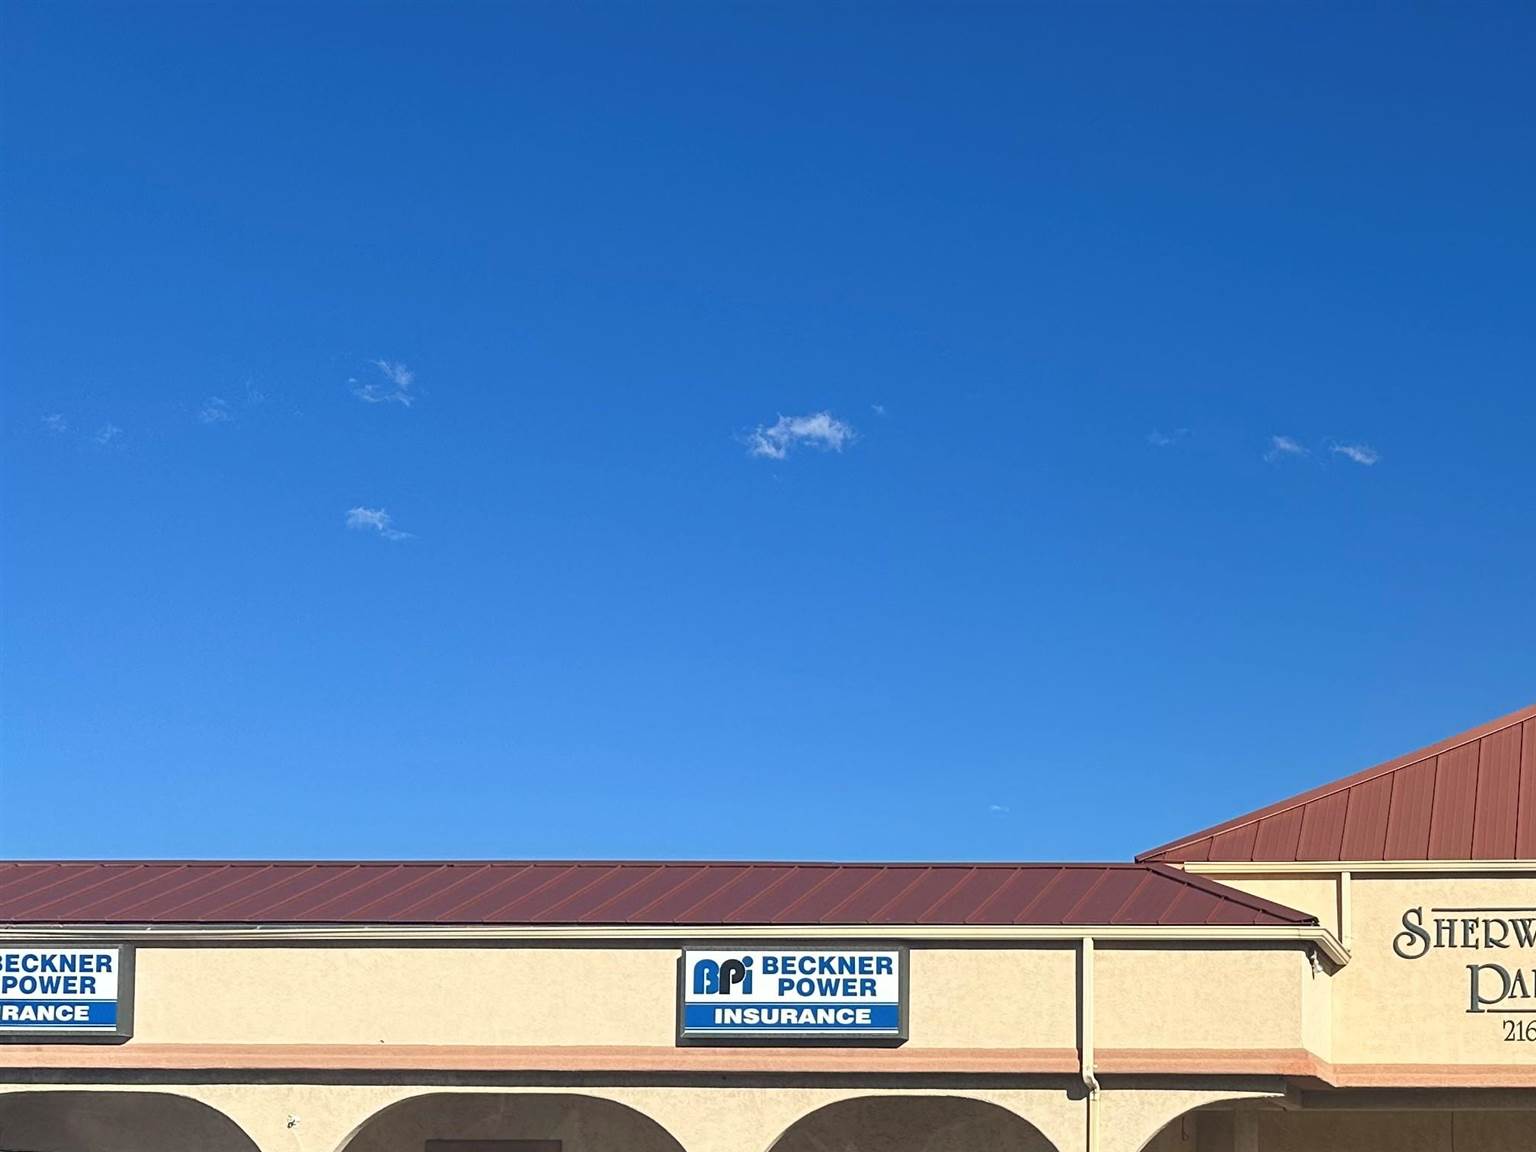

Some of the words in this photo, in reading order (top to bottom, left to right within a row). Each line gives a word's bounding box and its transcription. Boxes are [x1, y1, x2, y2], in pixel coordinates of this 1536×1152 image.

[0, 954, 113, 973] ECKNER
[762, 956, 893, 975] BECKNER
[2, 975, 96, 994] POWER
[778, 977, 877, 997] POWER
[0, 1004, 90, 1021] RANCE
[714, 1008, 872, 1025] INSURANCE
